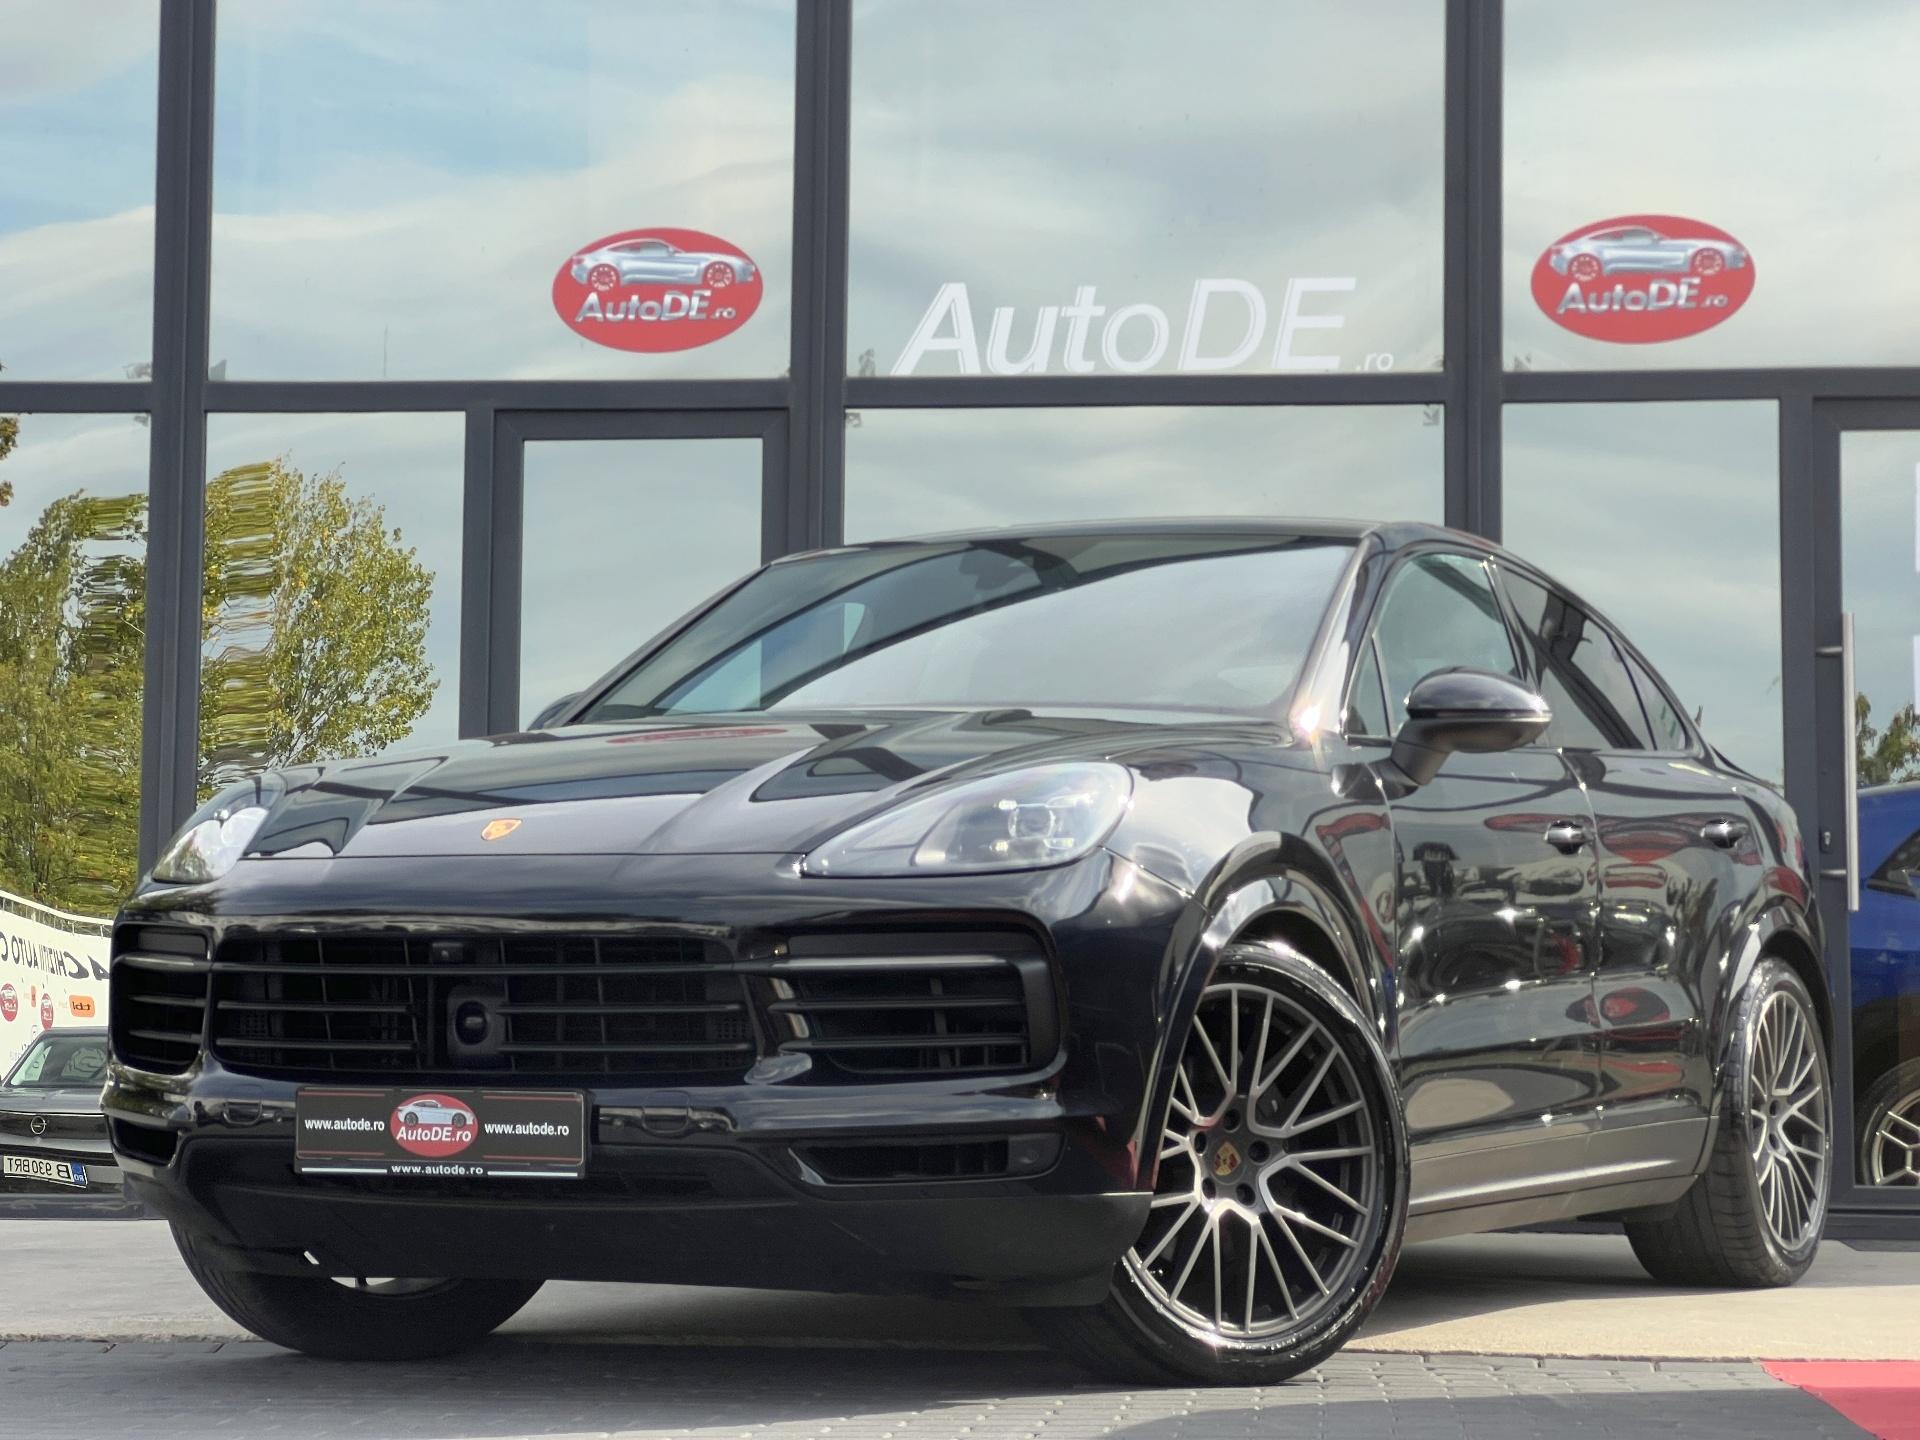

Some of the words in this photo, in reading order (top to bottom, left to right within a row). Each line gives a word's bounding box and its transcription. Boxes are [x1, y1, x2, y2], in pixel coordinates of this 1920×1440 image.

[304, 1117, 385, 1132] www.autode.ro
[484, 1121, 570, 1137] www.autode.ro
[395, 1125, 472, 1143] AutoDE.ro
[391, 1163, 484, 1176] www.autode.ro
